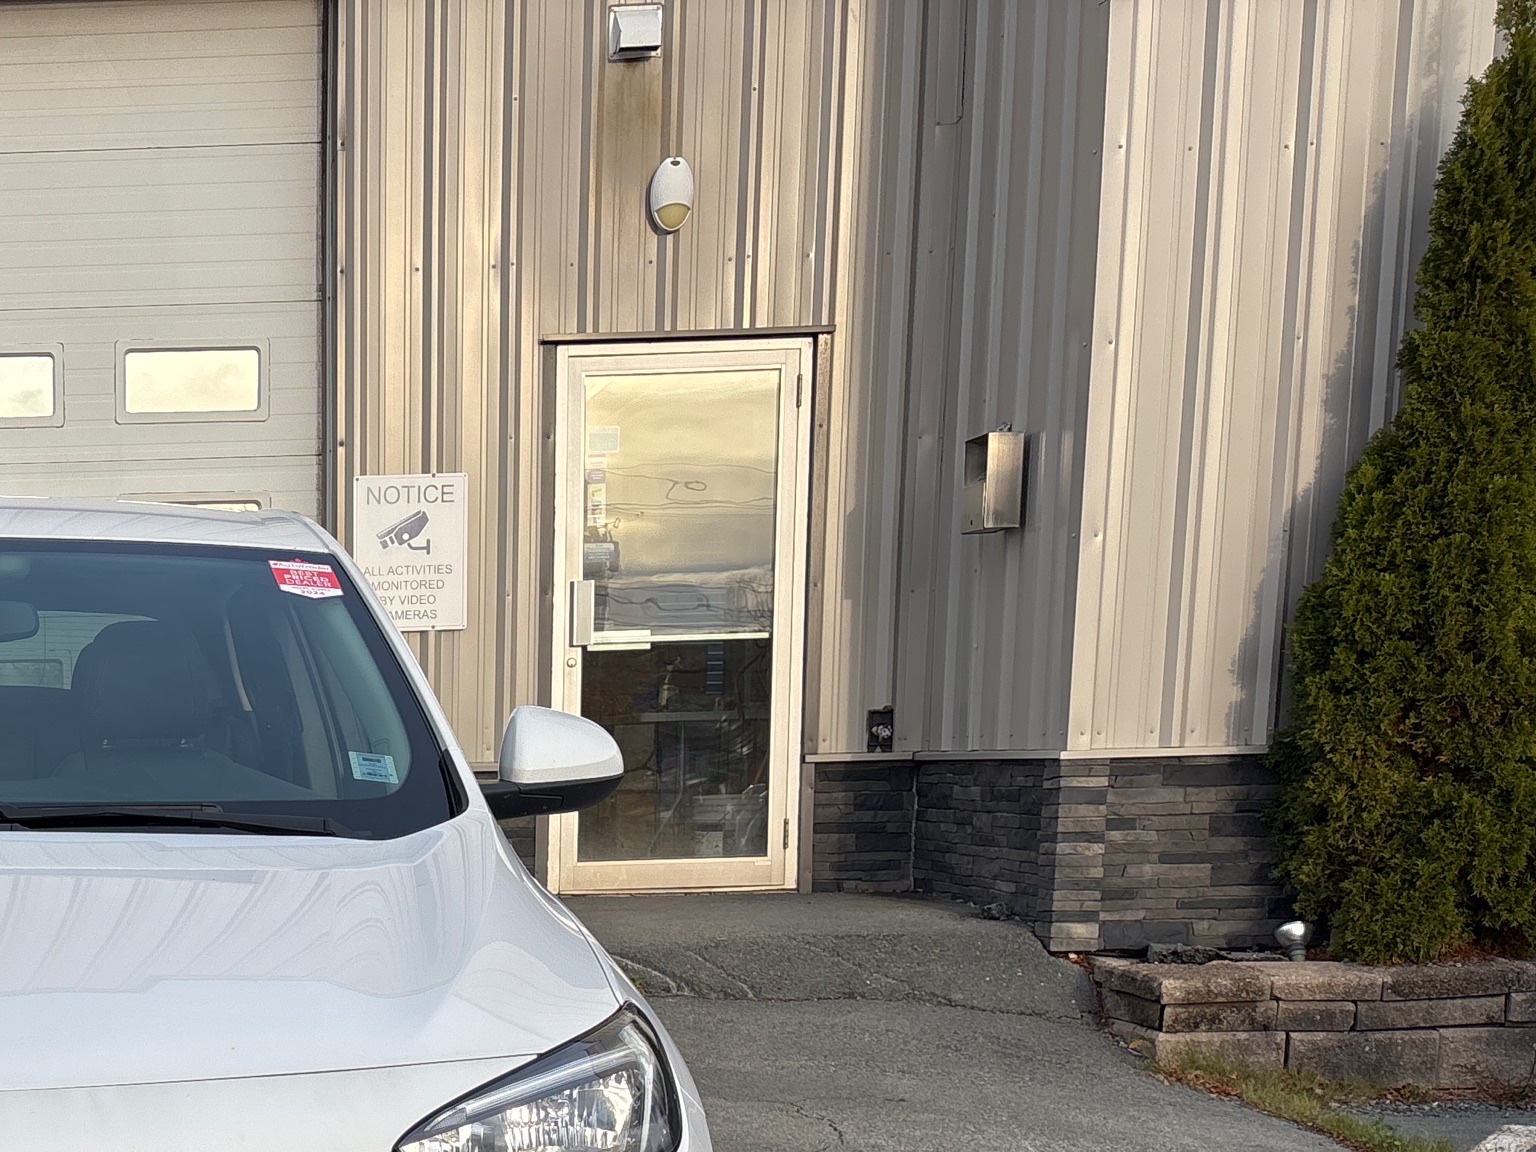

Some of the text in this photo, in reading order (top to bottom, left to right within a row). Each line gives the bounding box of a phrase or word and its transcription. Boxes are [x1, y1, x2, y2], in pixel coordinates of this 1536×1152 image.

[366, 484, 455, 505] NOTICE
[289, 569, 319, 577] BEST
[364, 564, 453, 577] ALL ACTIVITIES
[284, 574, 328, 582] PRICED
[285, 579, 332, 587] DEALER
[371, 579, 445, 592] MONITORED
[380, 594, 437, 606] BY VIDEO
[388, 609, 438, 621] AMERAS
